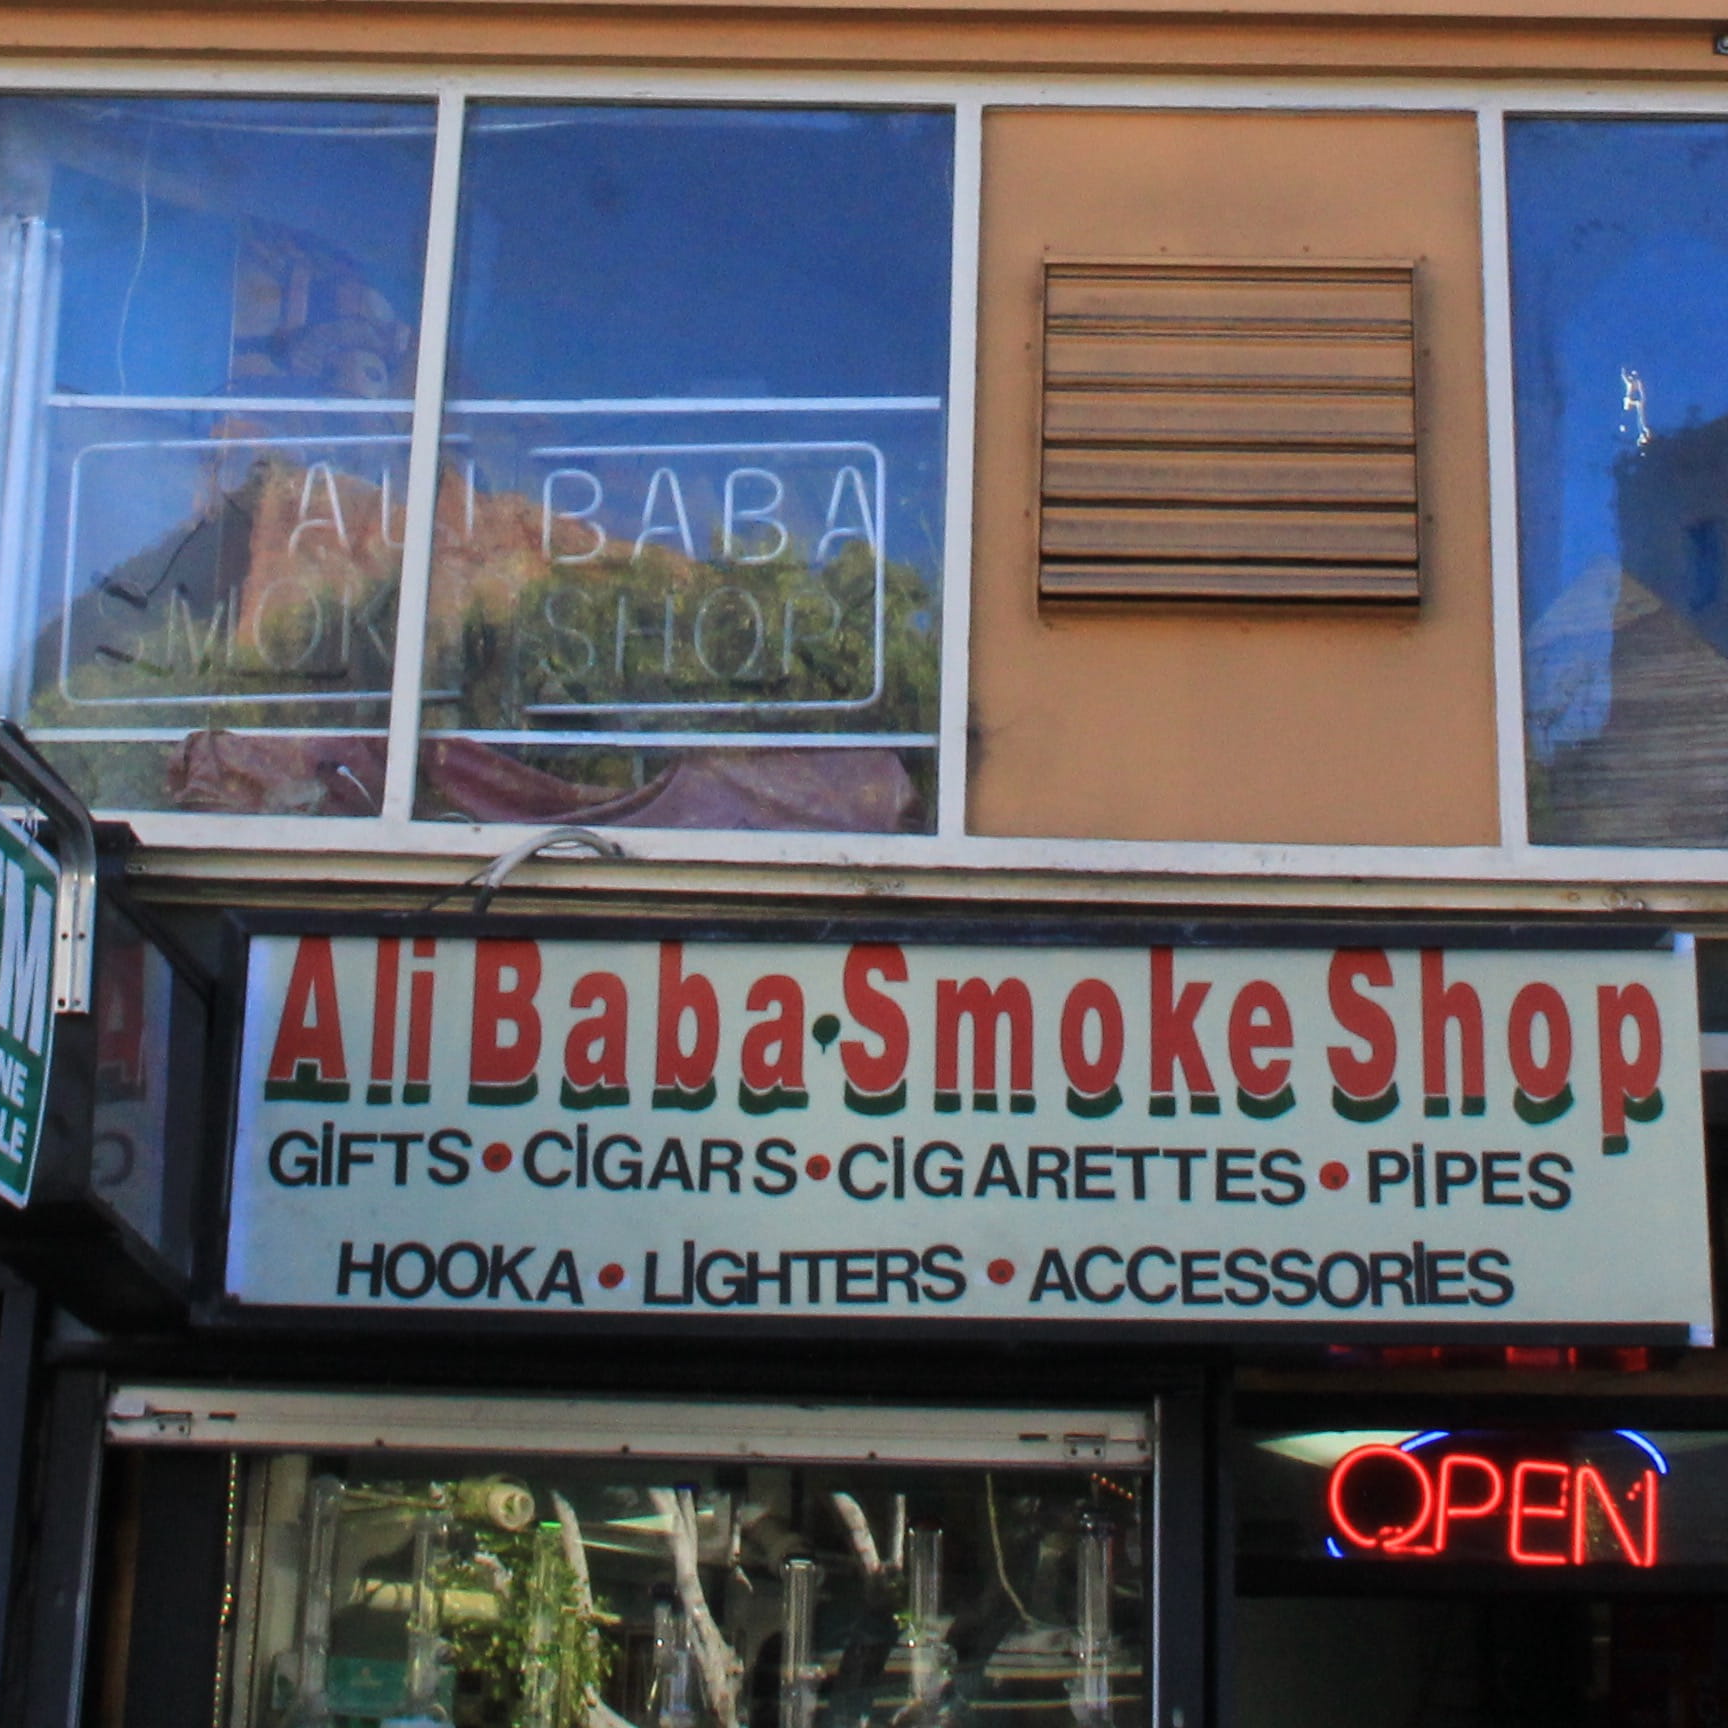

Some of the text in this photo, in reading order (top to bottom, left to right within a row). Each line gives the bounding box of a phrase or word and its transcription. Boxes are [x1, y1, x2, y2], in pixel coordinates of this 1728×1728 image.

[542, 467, 876, 565] BABA
[96, 584, 422, 676] SMOK
[265, 936, 436, 1104] Ali
[469, 939, 808, 1112] Baba
[839, 942, 1296, 1120] Smoke
[1327, 947, 1663, 1156] Shop
[337, 1241, 584, 1305] HOOKA
[1330, 1444, 1659, 1567] OPEN
